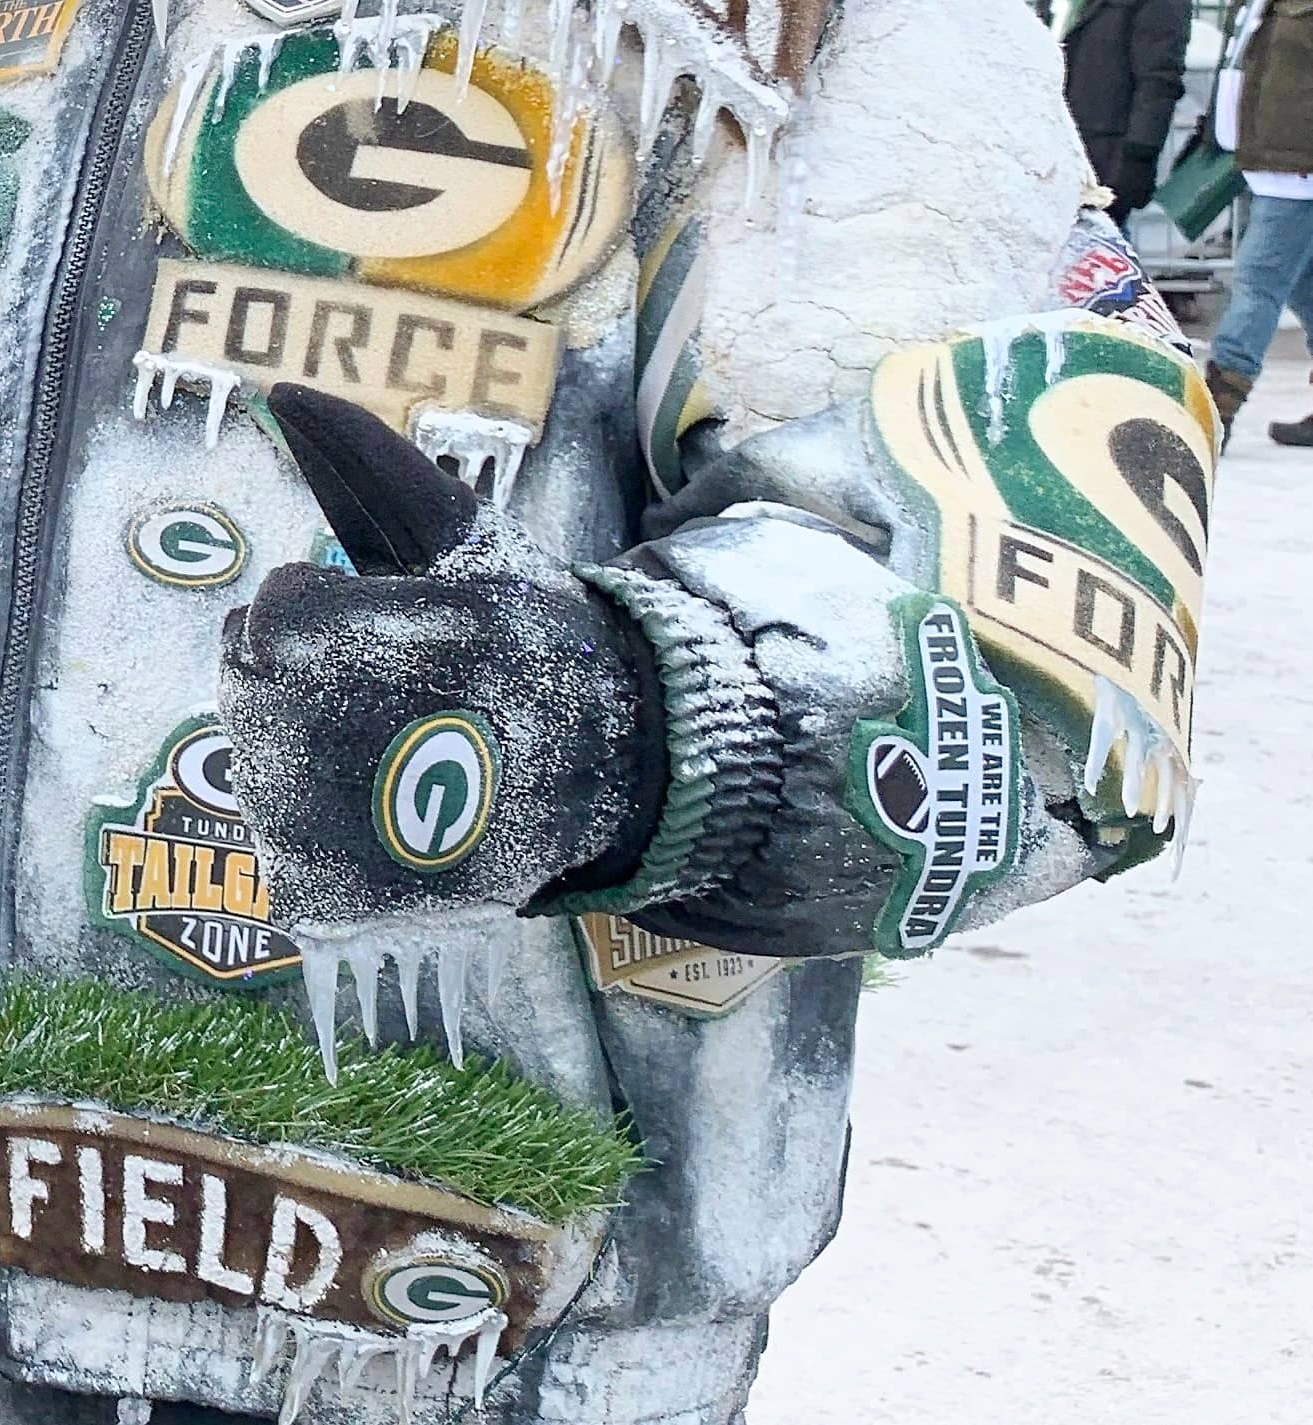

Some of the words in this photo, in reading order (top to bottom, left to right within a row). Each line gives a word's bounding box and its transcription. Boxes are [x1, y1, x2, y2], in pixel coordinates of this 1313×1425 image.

[161, 279, 529, 408] FORCE
[995, 533, 1187, 736] FOR
[923, 612, 970, 773] FROZEN
[980, 702, 1003, 747] WE
[981, 753, 1003, 807] ARE
[181, 816, 256, 843] TUND
[904, 783, 970, 940] TUNDRA
[976, 811, 1002, 864] THE
[179, 916, 273, 967] ZONE
[7, 1136, 344, 1314] FIELD
